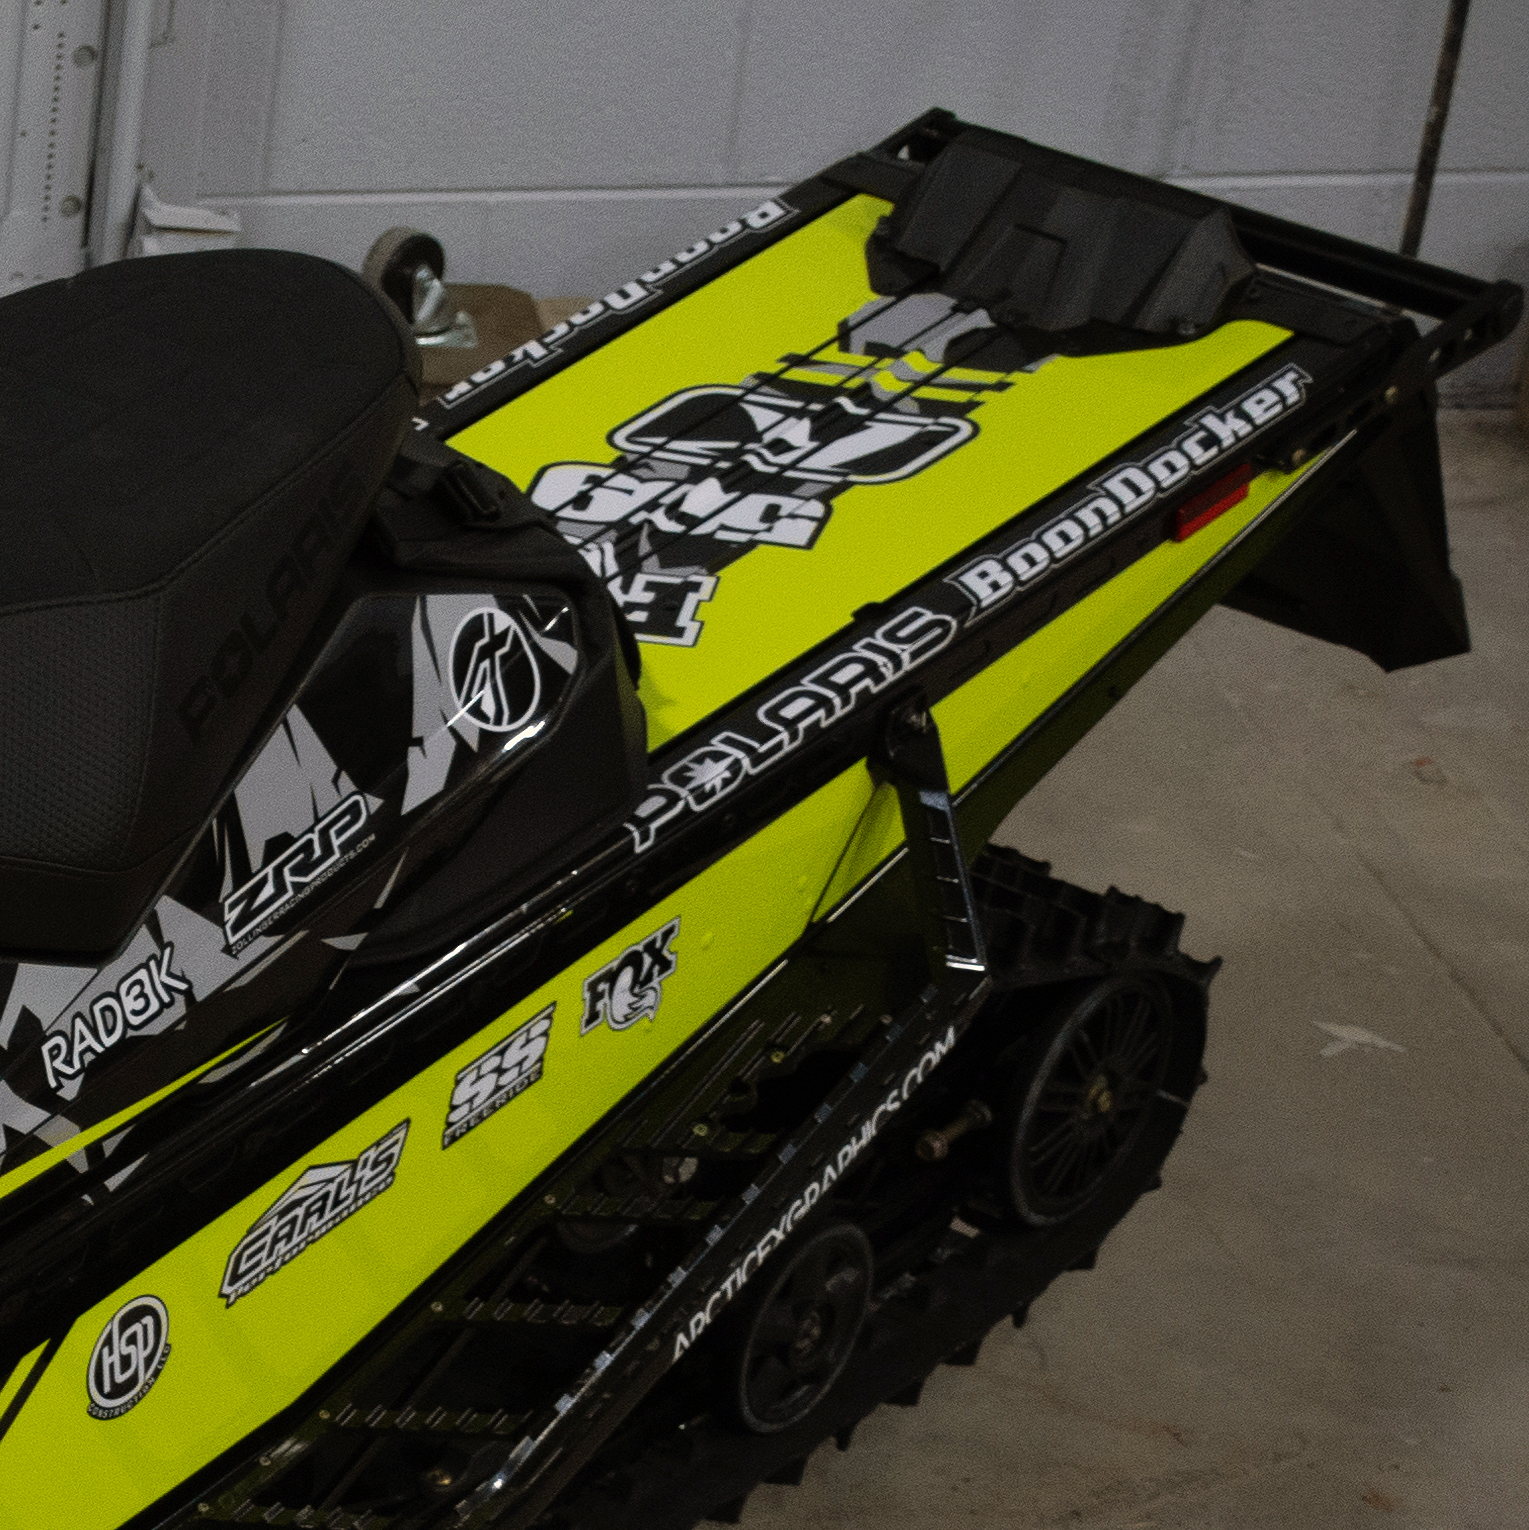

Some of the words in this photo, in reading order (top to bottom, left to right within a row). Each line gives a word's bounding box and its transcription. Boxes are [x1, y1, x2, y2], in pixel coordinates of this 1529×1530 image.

[954, 366, 1307, 612] BoonDocker
[624, 606, 957, 853] POLARIS
[224, 794, 368, 944] ZRP
[582, 916, 680, 1036] FOX
